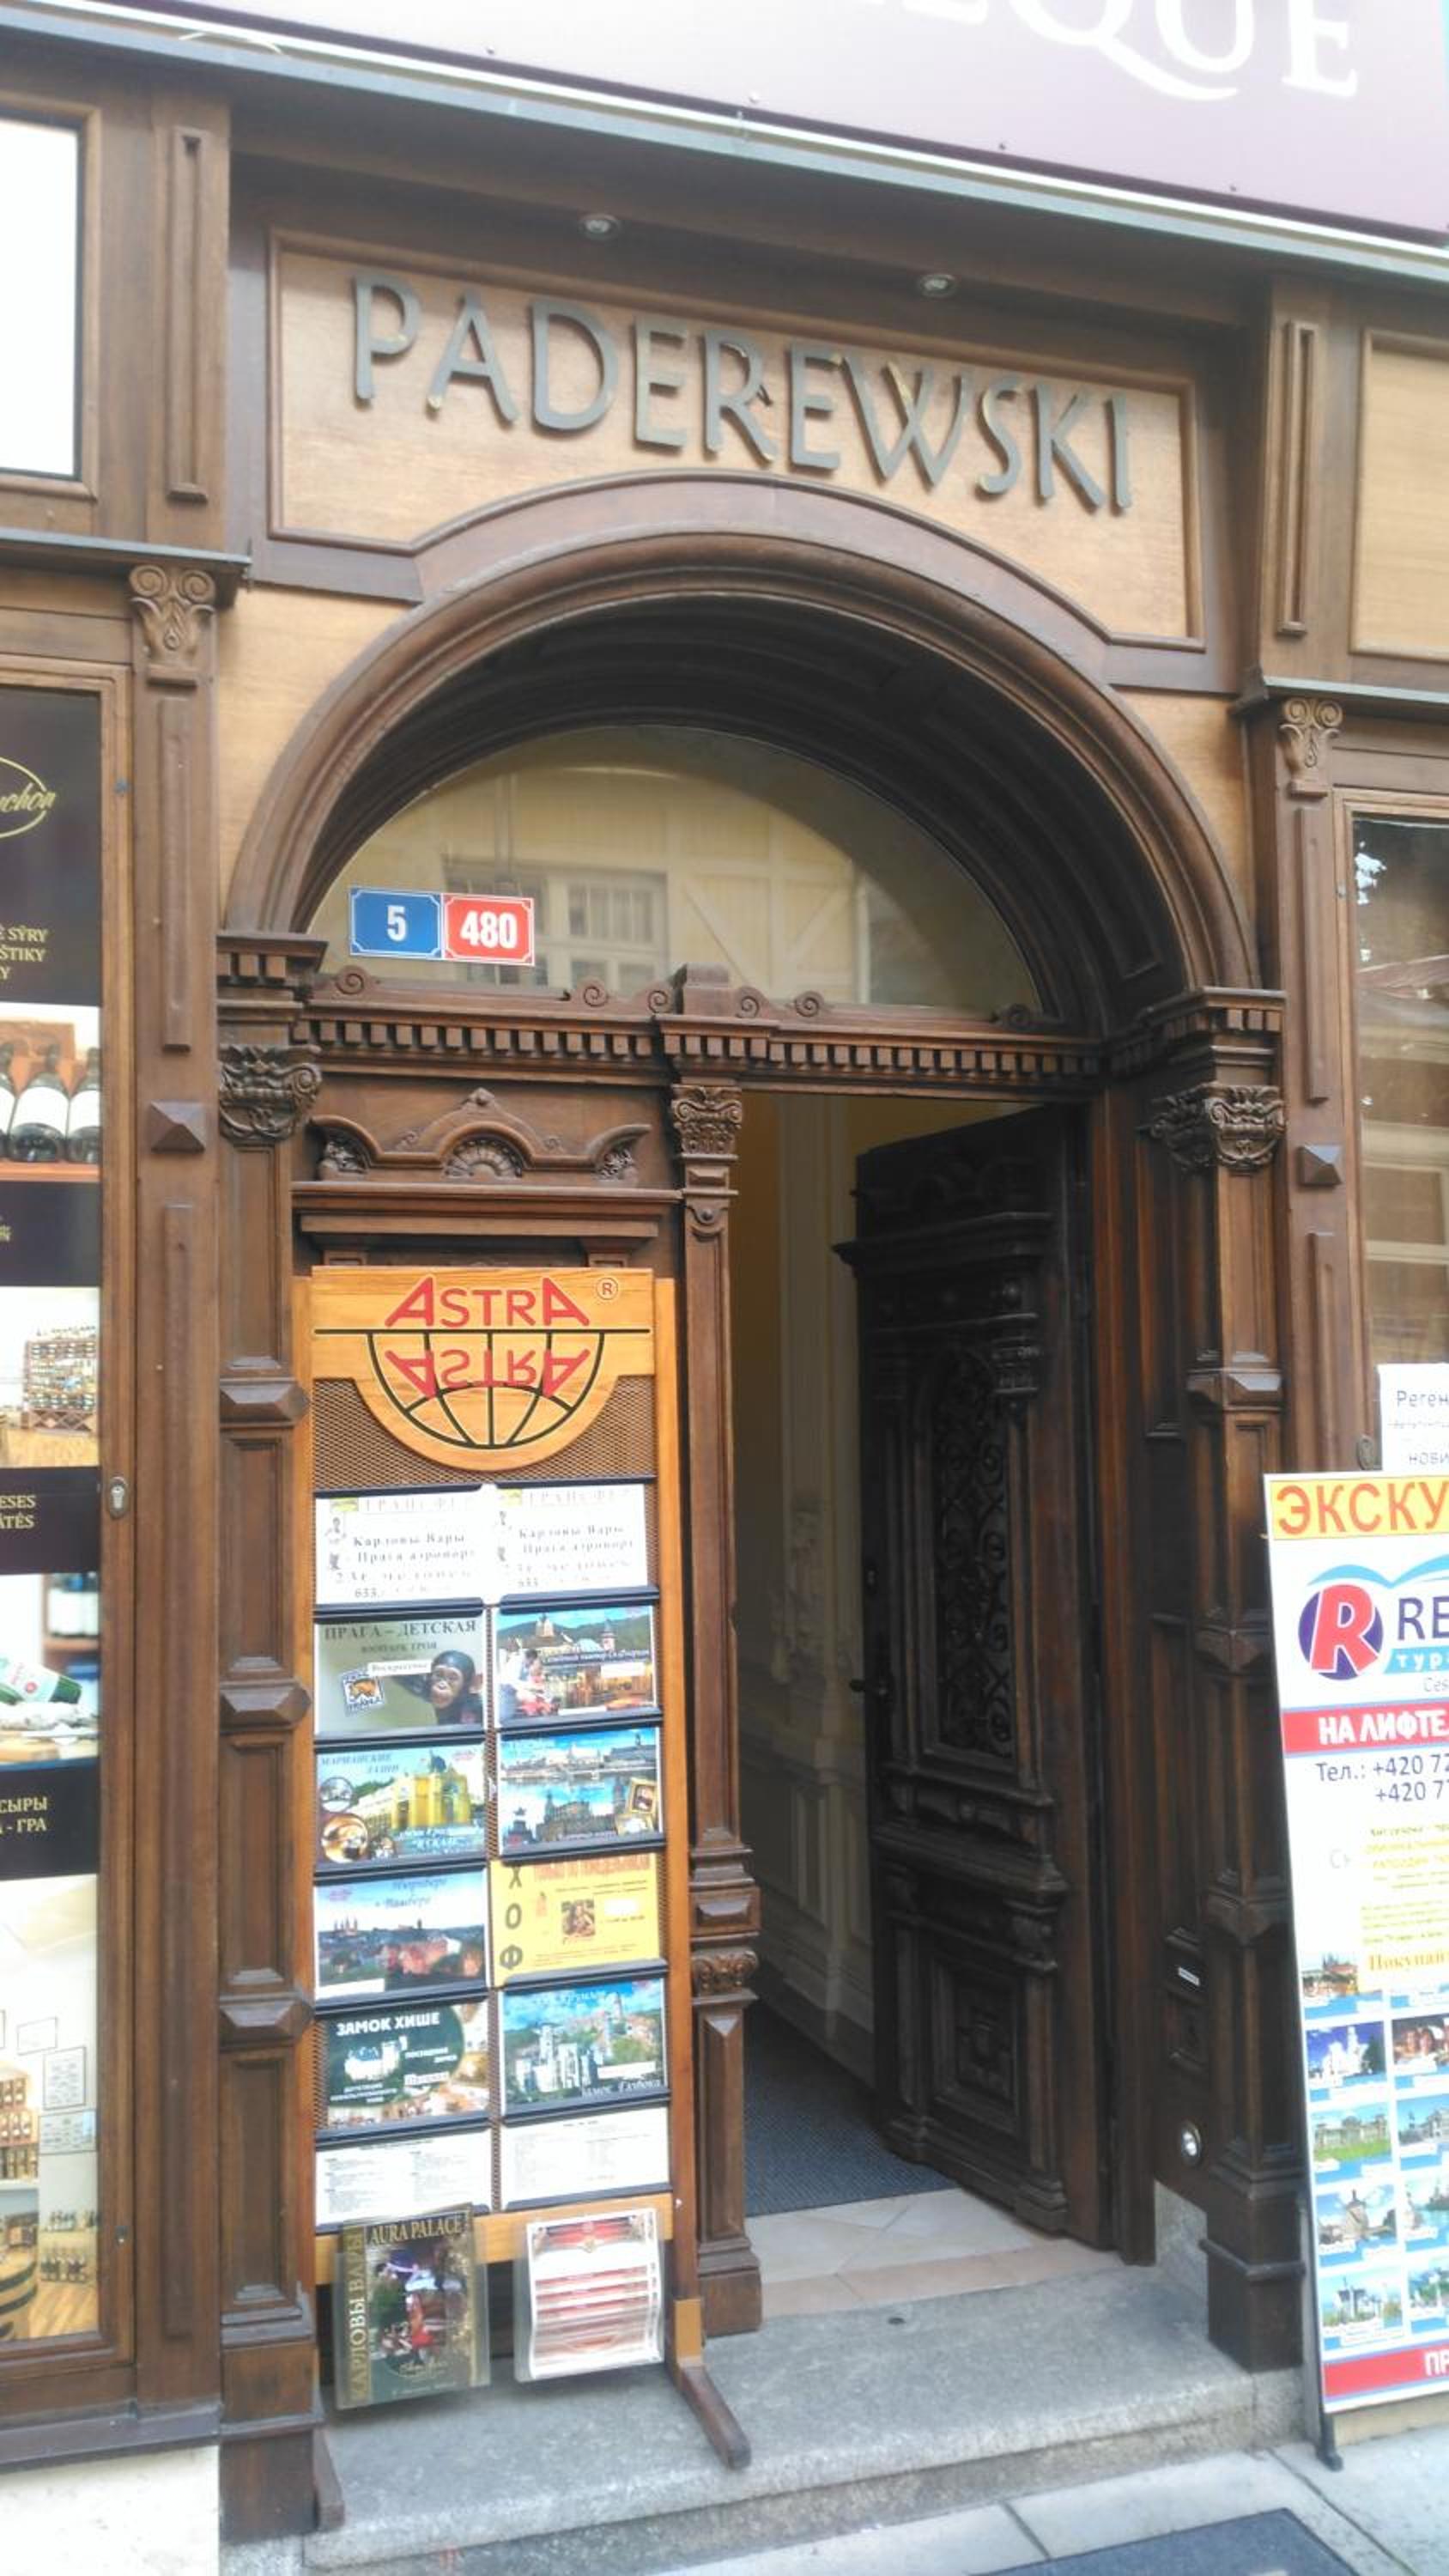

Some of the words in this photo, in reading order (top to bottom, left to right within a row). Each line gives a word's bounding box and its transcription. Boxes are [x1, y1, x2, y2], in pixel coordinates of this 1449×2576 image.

[353, 272, 1133, 517] PADEREWSKI
[386, 904, 408, 942] 5
[460, 910, 518, 949] 480
[385, 1276, 591, 1327] ASTRA
[1276, 1481, 1449, 1536] ЭКСКУ
[1318, 1715, 1356, 1745] НА
[1360, 1710, 1449, 1742] ЛИФТЕ
[1373, 1755, 1424, 1777] +420
[1376, 1781, 1427, 1802] +420
[1433, 1779, 1449, 1800] 7
[336, 2017, 391, 2037] ЗАМОК
